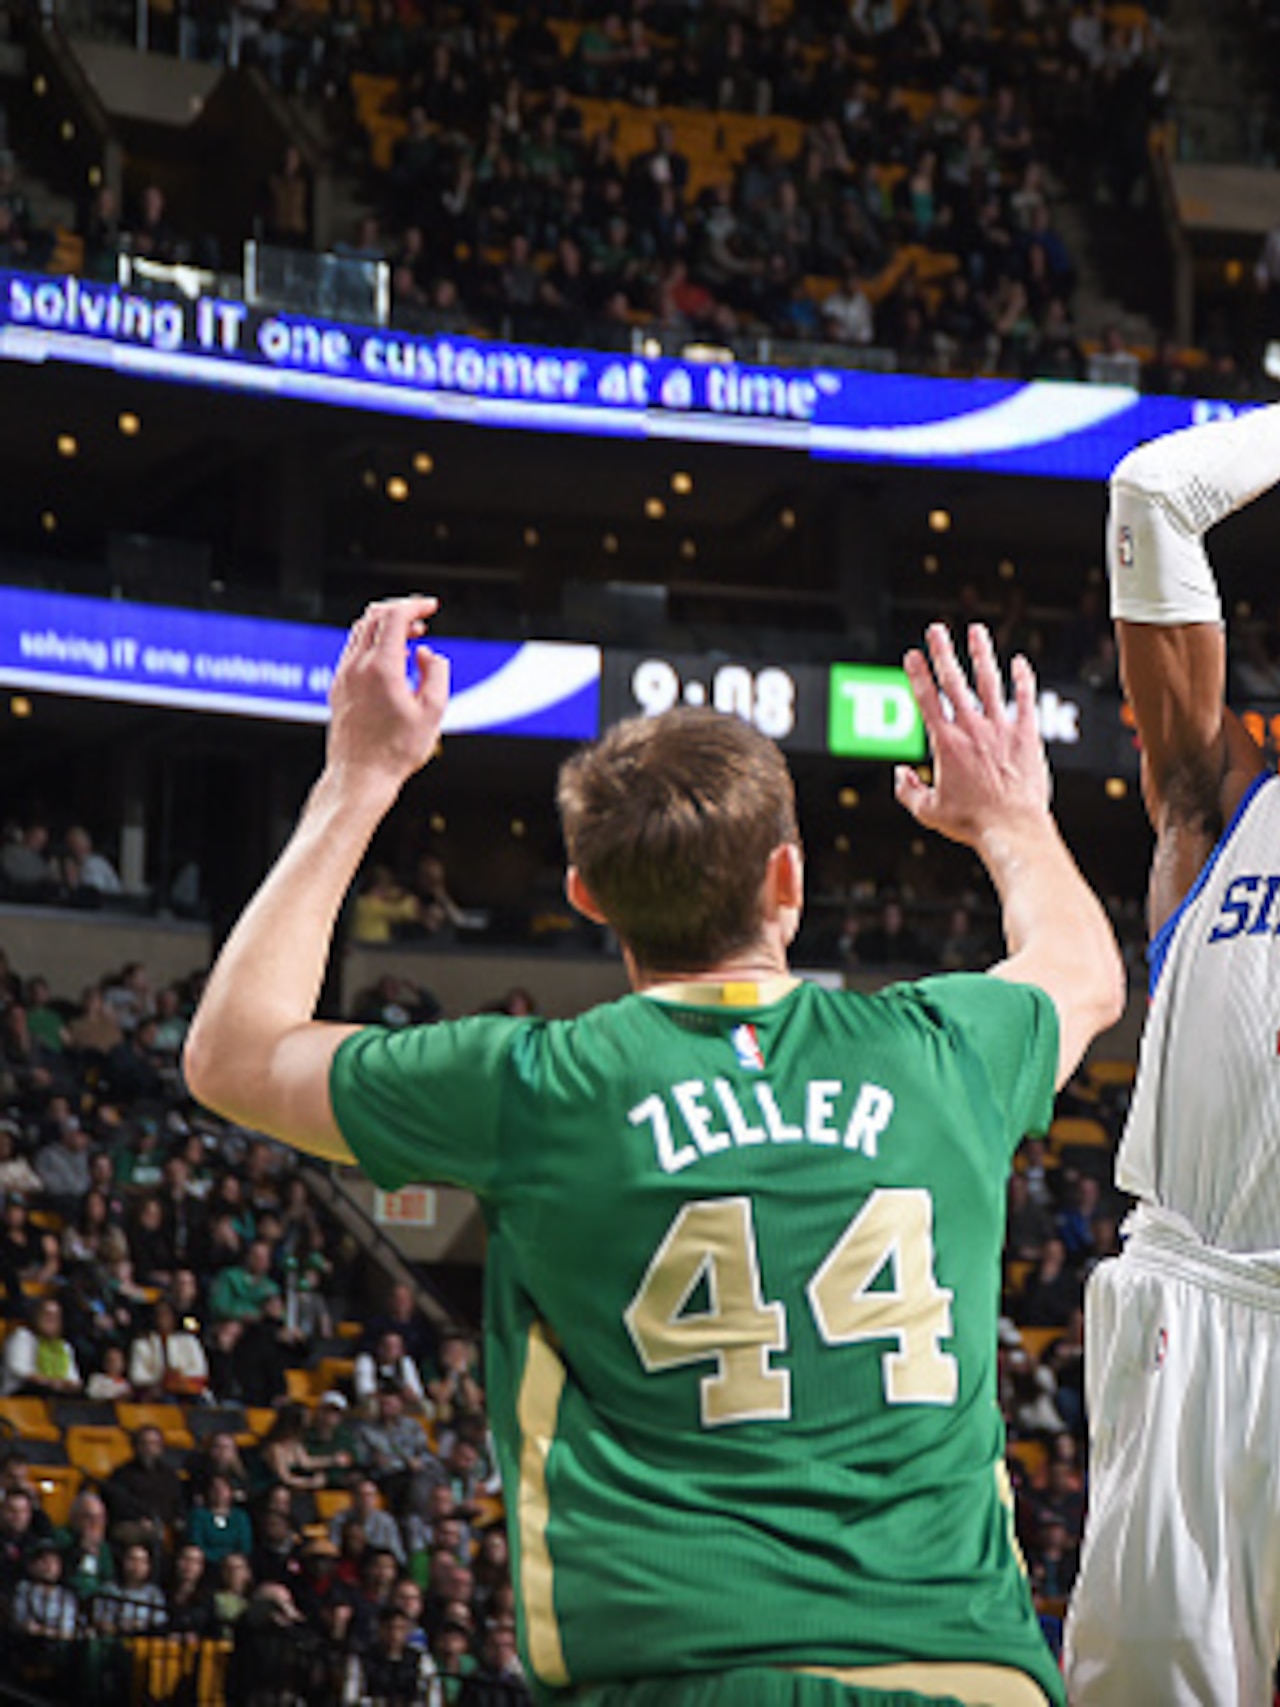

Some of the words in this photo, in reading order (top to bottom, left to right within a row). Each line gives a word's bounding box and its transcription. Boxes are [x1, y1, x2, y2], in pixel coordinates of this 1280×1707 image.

[9, 272, 184, 351] solving
[198, 295, 247, 353] IT
[257, 317, 352, 373] one
[361, 336, 585, 399] customer
[597, 361, 648, 404] at
[660, 366, 692, 409] a
[19, 629, 107, 672] solving
[112, 637, 138, 669] IT
[142, 645, 190, 676] one
[194, 652, 304, 690] customer
[627, 1077, 894, 1174] ZELLER
[622, 1187, 959, 1427] 44
